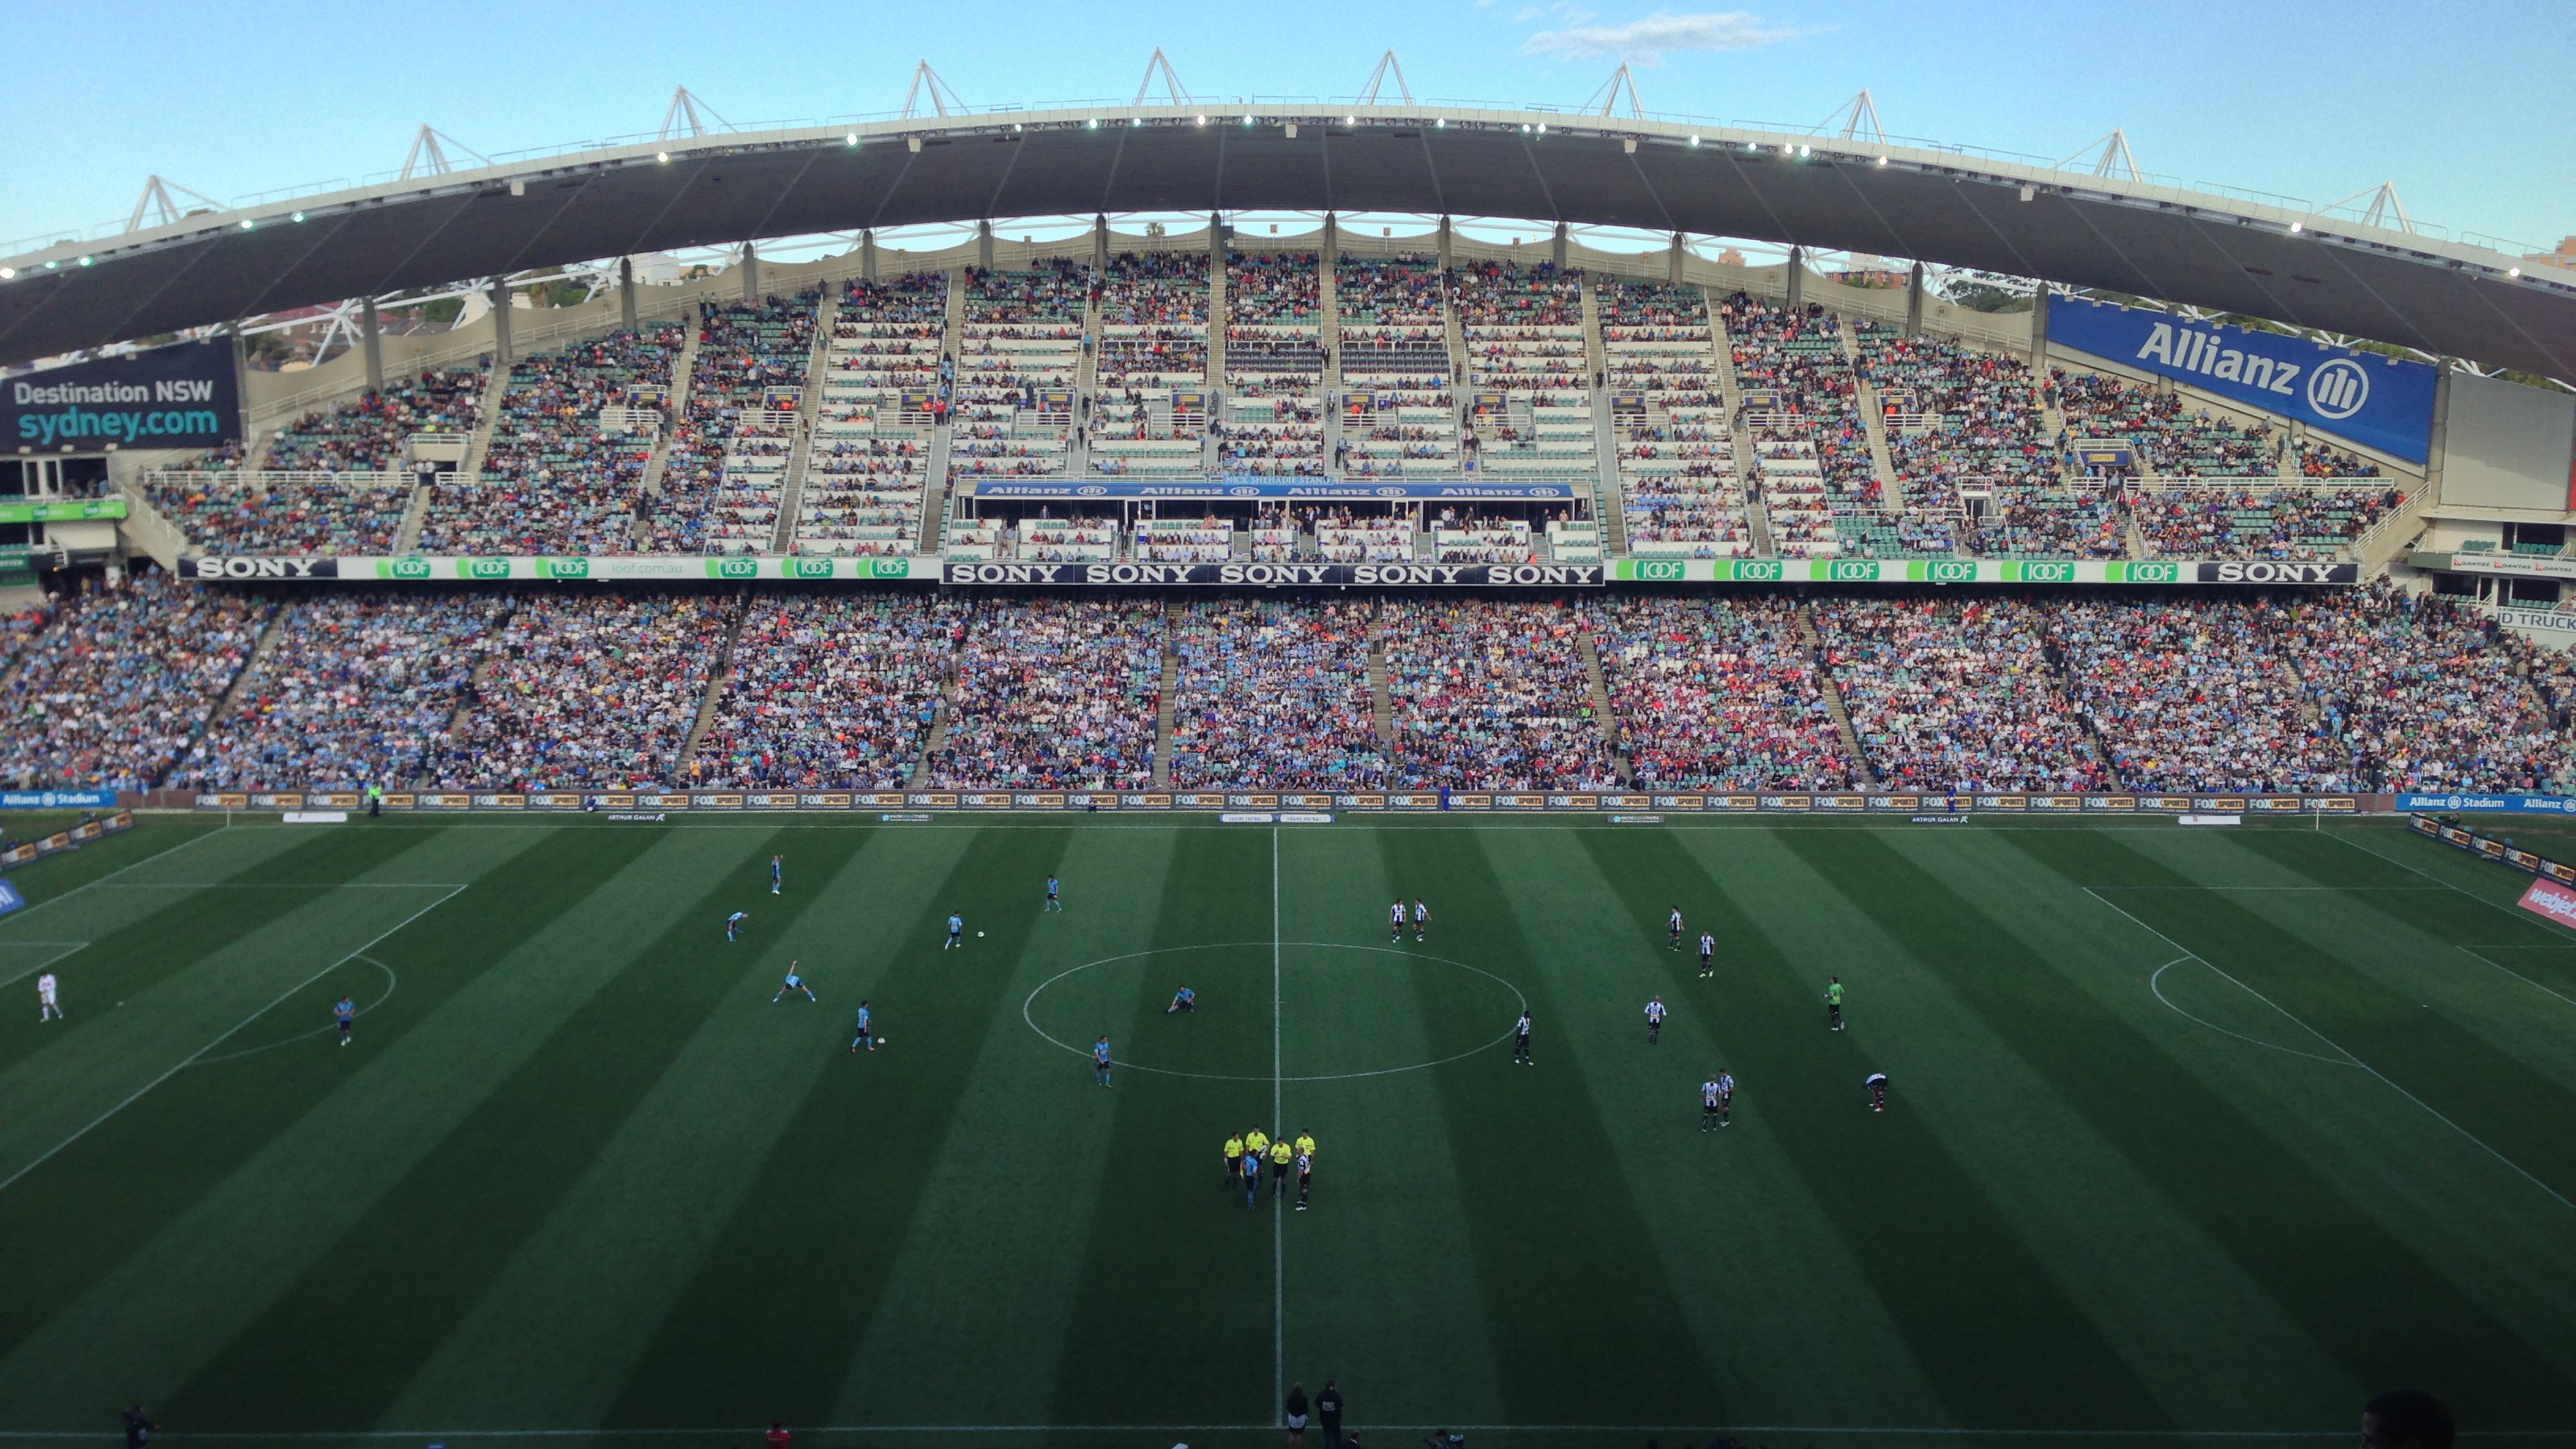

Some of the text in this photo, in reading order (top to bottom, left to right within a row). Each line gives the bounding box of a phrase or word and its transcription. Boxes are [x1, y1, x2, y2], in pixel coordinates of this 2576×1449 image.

[2136, 321, 2301, 395] Allianz
[14, 380, 214, 405] Destination NSW
[18, 406, 219, 445] sydney.com
[987, 486, 1071, 495] Allianz
[1288, 487, 1370, 496] Allianz
[197, 557, 316, 578] SONY
[396, 562, 429, 575] IOOF
[477, 562, 508, 575] IOOF
[556, 561, 586, 575] IOOF
[612, 563, 683, 574] ioof.com.au
[724, 561, 754, 575] IOOF
[801, 561, 830, 575] IOOF
[878, 561, 906, 575] IOOF
[1643, 562, 1682, 579] IOOF
[1740, 562, 1779, 579] IOOF
[1837, 562, 1877, 579] IOOF
[1934, 564, 1973, 580] IOOF
[2028, 564, 2069, 580] IOOF
[2133, 564, 2175, 581] IOOF
[2218, 564, 2338, 582] SONY
[952, 565, 1061, 582] SONY
[1087, 565, 1196, 582] SONY
[1220, 565, 1330, 583] SONY
[1354, 566, 1464, 584] SONY
[1488, 566, 1597, 584] SONY
[3, 792, 99, 805] Allianz Stadium
[196, 795, 219, 806] FOX
[252, 795, 301, 806] FOX SPORTS
[307, 795, 356, 806] FOX SPORTS
[418, 795, 442, 806] FOX
[474, 795, 498, 806] FOX
[530, 795, 578, 806] FOX SPORTS
[608, 796, 632, 805] SPORTS
[638, 796, 687, 806] FOX SPORTS
[693, 795, 716, 806] FOX
[747, 795, 770, 805] FOX
[801, 794, 824, 805] FOX
[855, 794, 902, 805] FOX SPORTS
[908, 794, 931, 805] FOX
[962, 794, 984, 805] FOX
[1016, 794, 1062, 805] FOX SPORTS
[1069, 794, 1091, 805] FOX
[1122, 794, 1169, 805] FOX SPORTS
[1176, 794, 1222, 805] FOX SPORTS
[1230, 795, 1251, 806] FOX
[1282, 795, 1305, 806] FOX
[1336, 796, 1383, 806] FOX SPORTS
[1389, 796, 1436, 806] FOX SPORTS
[1449, 796, 1489, 806] OX SPORTS
[1496, 796, 1542, 806] FOX SPORTS
[1548, 796, 1571, 806] FOX
[1601, 796, 1623, 806] FOX
[1655, 796, 1677, 807] FOX
[1708, 796, 1755, 807] FOX SPORTS
[1762, 796, 1784, 807] FOX
[1815, 796, 1837, 807] FOX
[1869, 797, 1891, 807] FOX
[1923, 797, 1945, 807] FOX
[1977, 797, 2024, 807] FOX SPORTS
[2031, 797, 2054, 807] FOX
[2085, 797, 2108, 808] FOX
[2140, 798, 2162, 808] FOX
[2195, 799, 2243, 809] FOX SPORTS
[2249, 799, 2298, 809] FOX SPORTS
[2328, 799, 2353, 808] SPORTS
[2409, 797, 2505, 808] Allianz Stadium
[2523, 799, 2561, 809] Allianz
[2410, 817, 2422, 829] FOX
[2439, 826, 2453, 839] FOX
[2472, 837, 2486, 851] FOX
[2505, 848, 2519, 862] FOX
[2540, 859, 2555, 874] FOX
